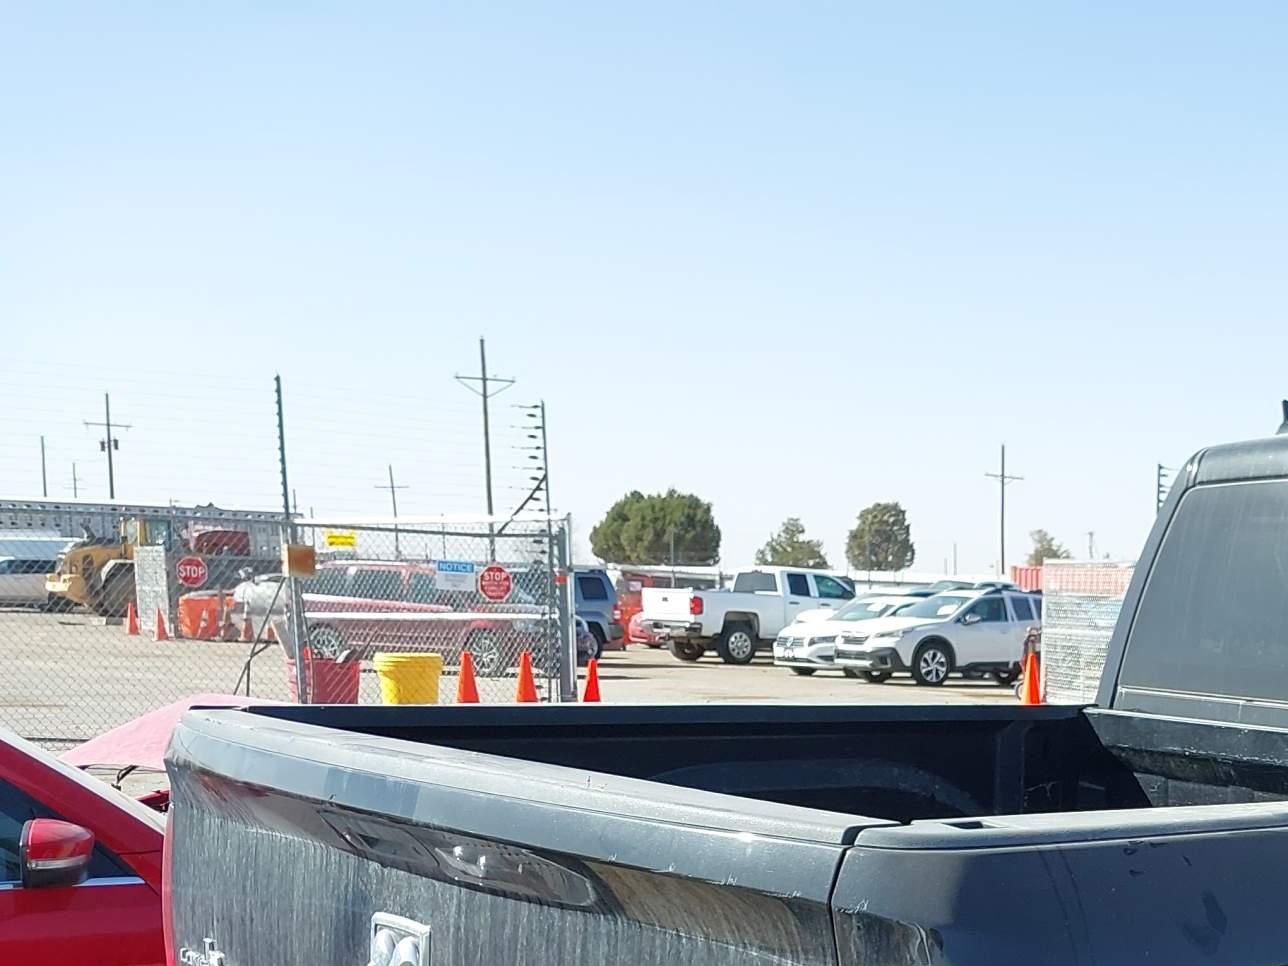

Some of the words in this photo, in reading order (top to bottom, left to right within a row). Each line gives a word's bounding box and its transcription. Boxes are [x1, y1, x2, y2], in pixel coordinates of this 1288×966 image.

[179, 564, 205, 577] STOP
[439, 562, 473, 572] NOTICE
[484, 572, 507, 581] STOP
